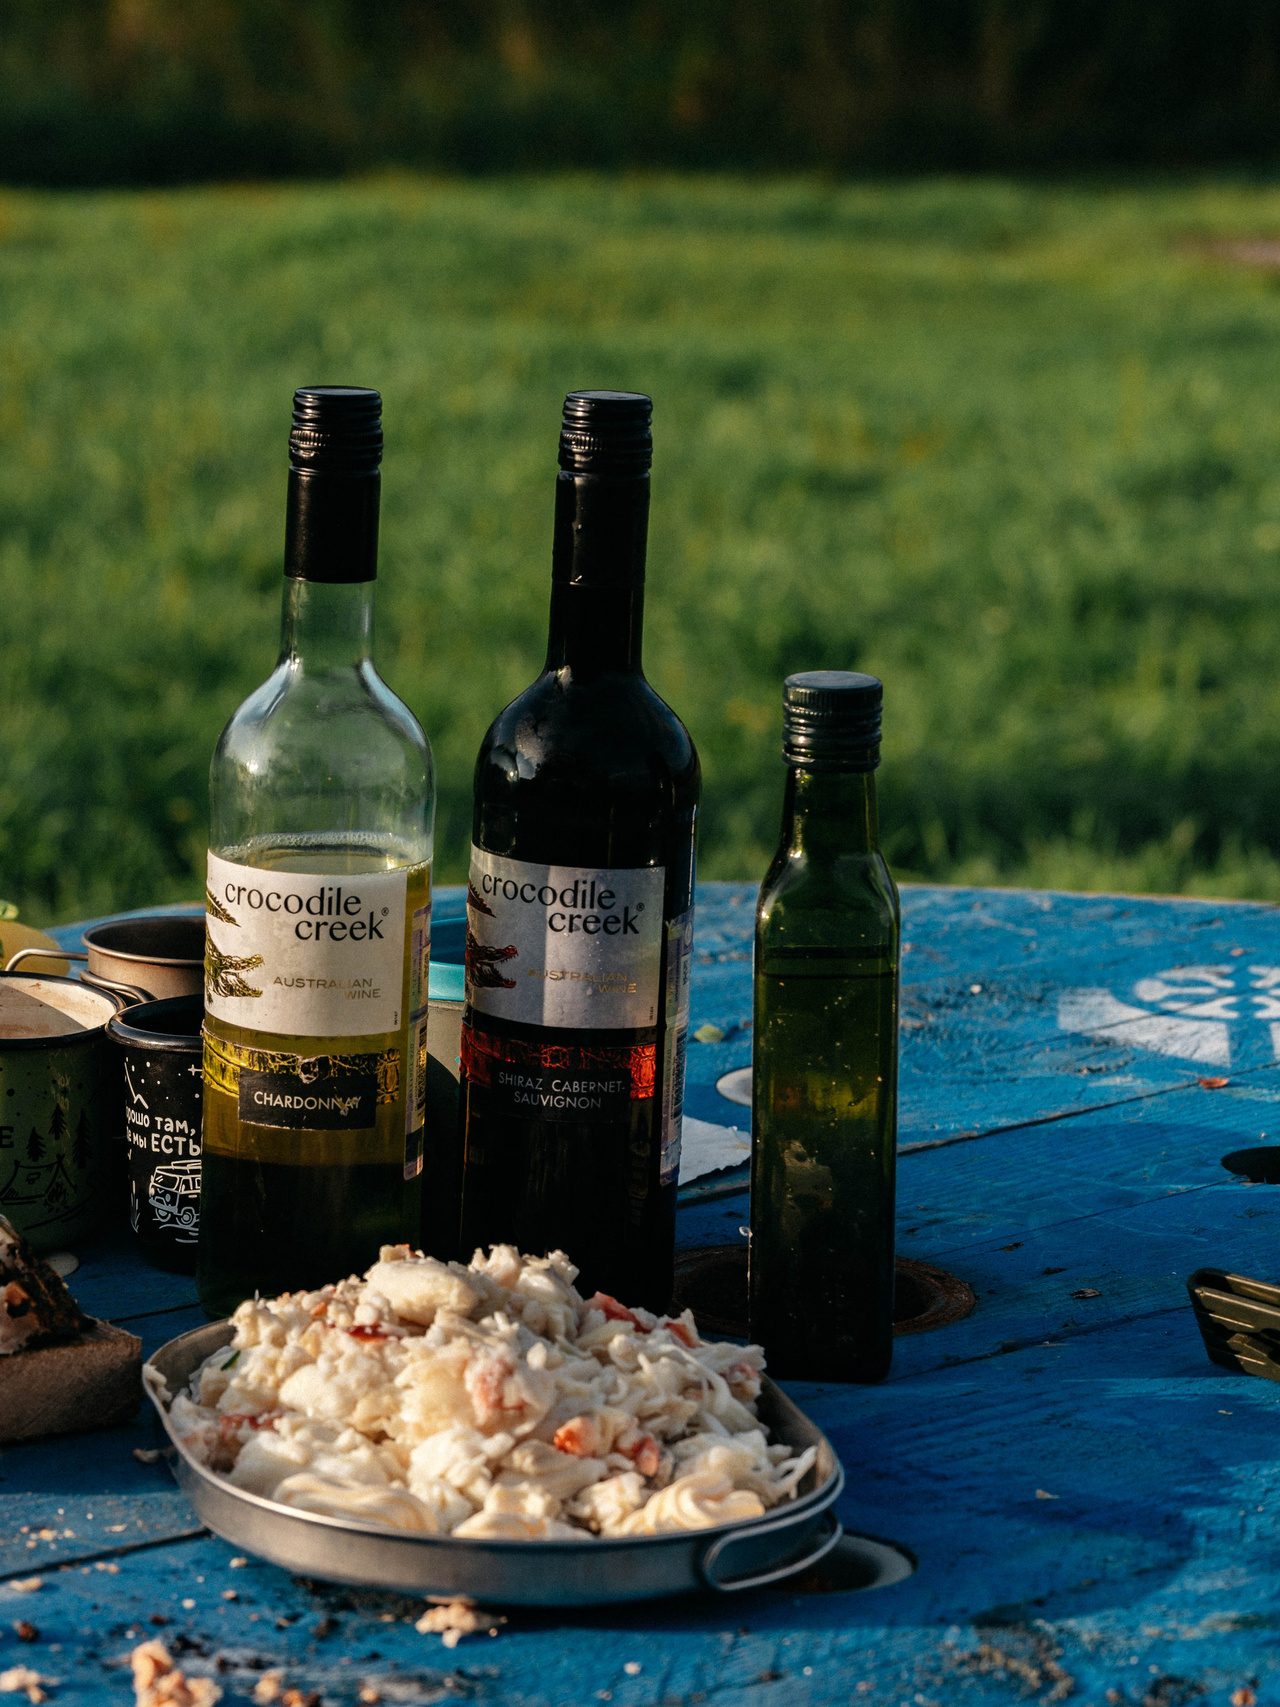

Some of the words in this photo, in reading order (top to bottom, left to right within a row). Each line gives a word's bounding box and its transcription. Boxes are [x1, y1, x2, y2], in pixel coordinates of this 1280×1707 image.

[225, 883, 362, 917] crocodile
[482, 873, 616, 910] crocodile
[294, 911, 384, 941] creek
[548, 905, 640, 935] creek
[273, 976, 373, 990] AUSTRALIAN
[527, 968, 627, 983] AUSTRALIAN
[344, 988, 381, 1000] WINE
[598, 982, 637, 994] WINE
[498, 1071, 543, 1091] SHIRAZ
[513, 1090, 602, 1109] SAUVIGNON
[154, 1116, 196, 1137] там,
[133, 1132, 147, 1149] мы
[151, 1133, 201, 1156] ЕСТЬ
